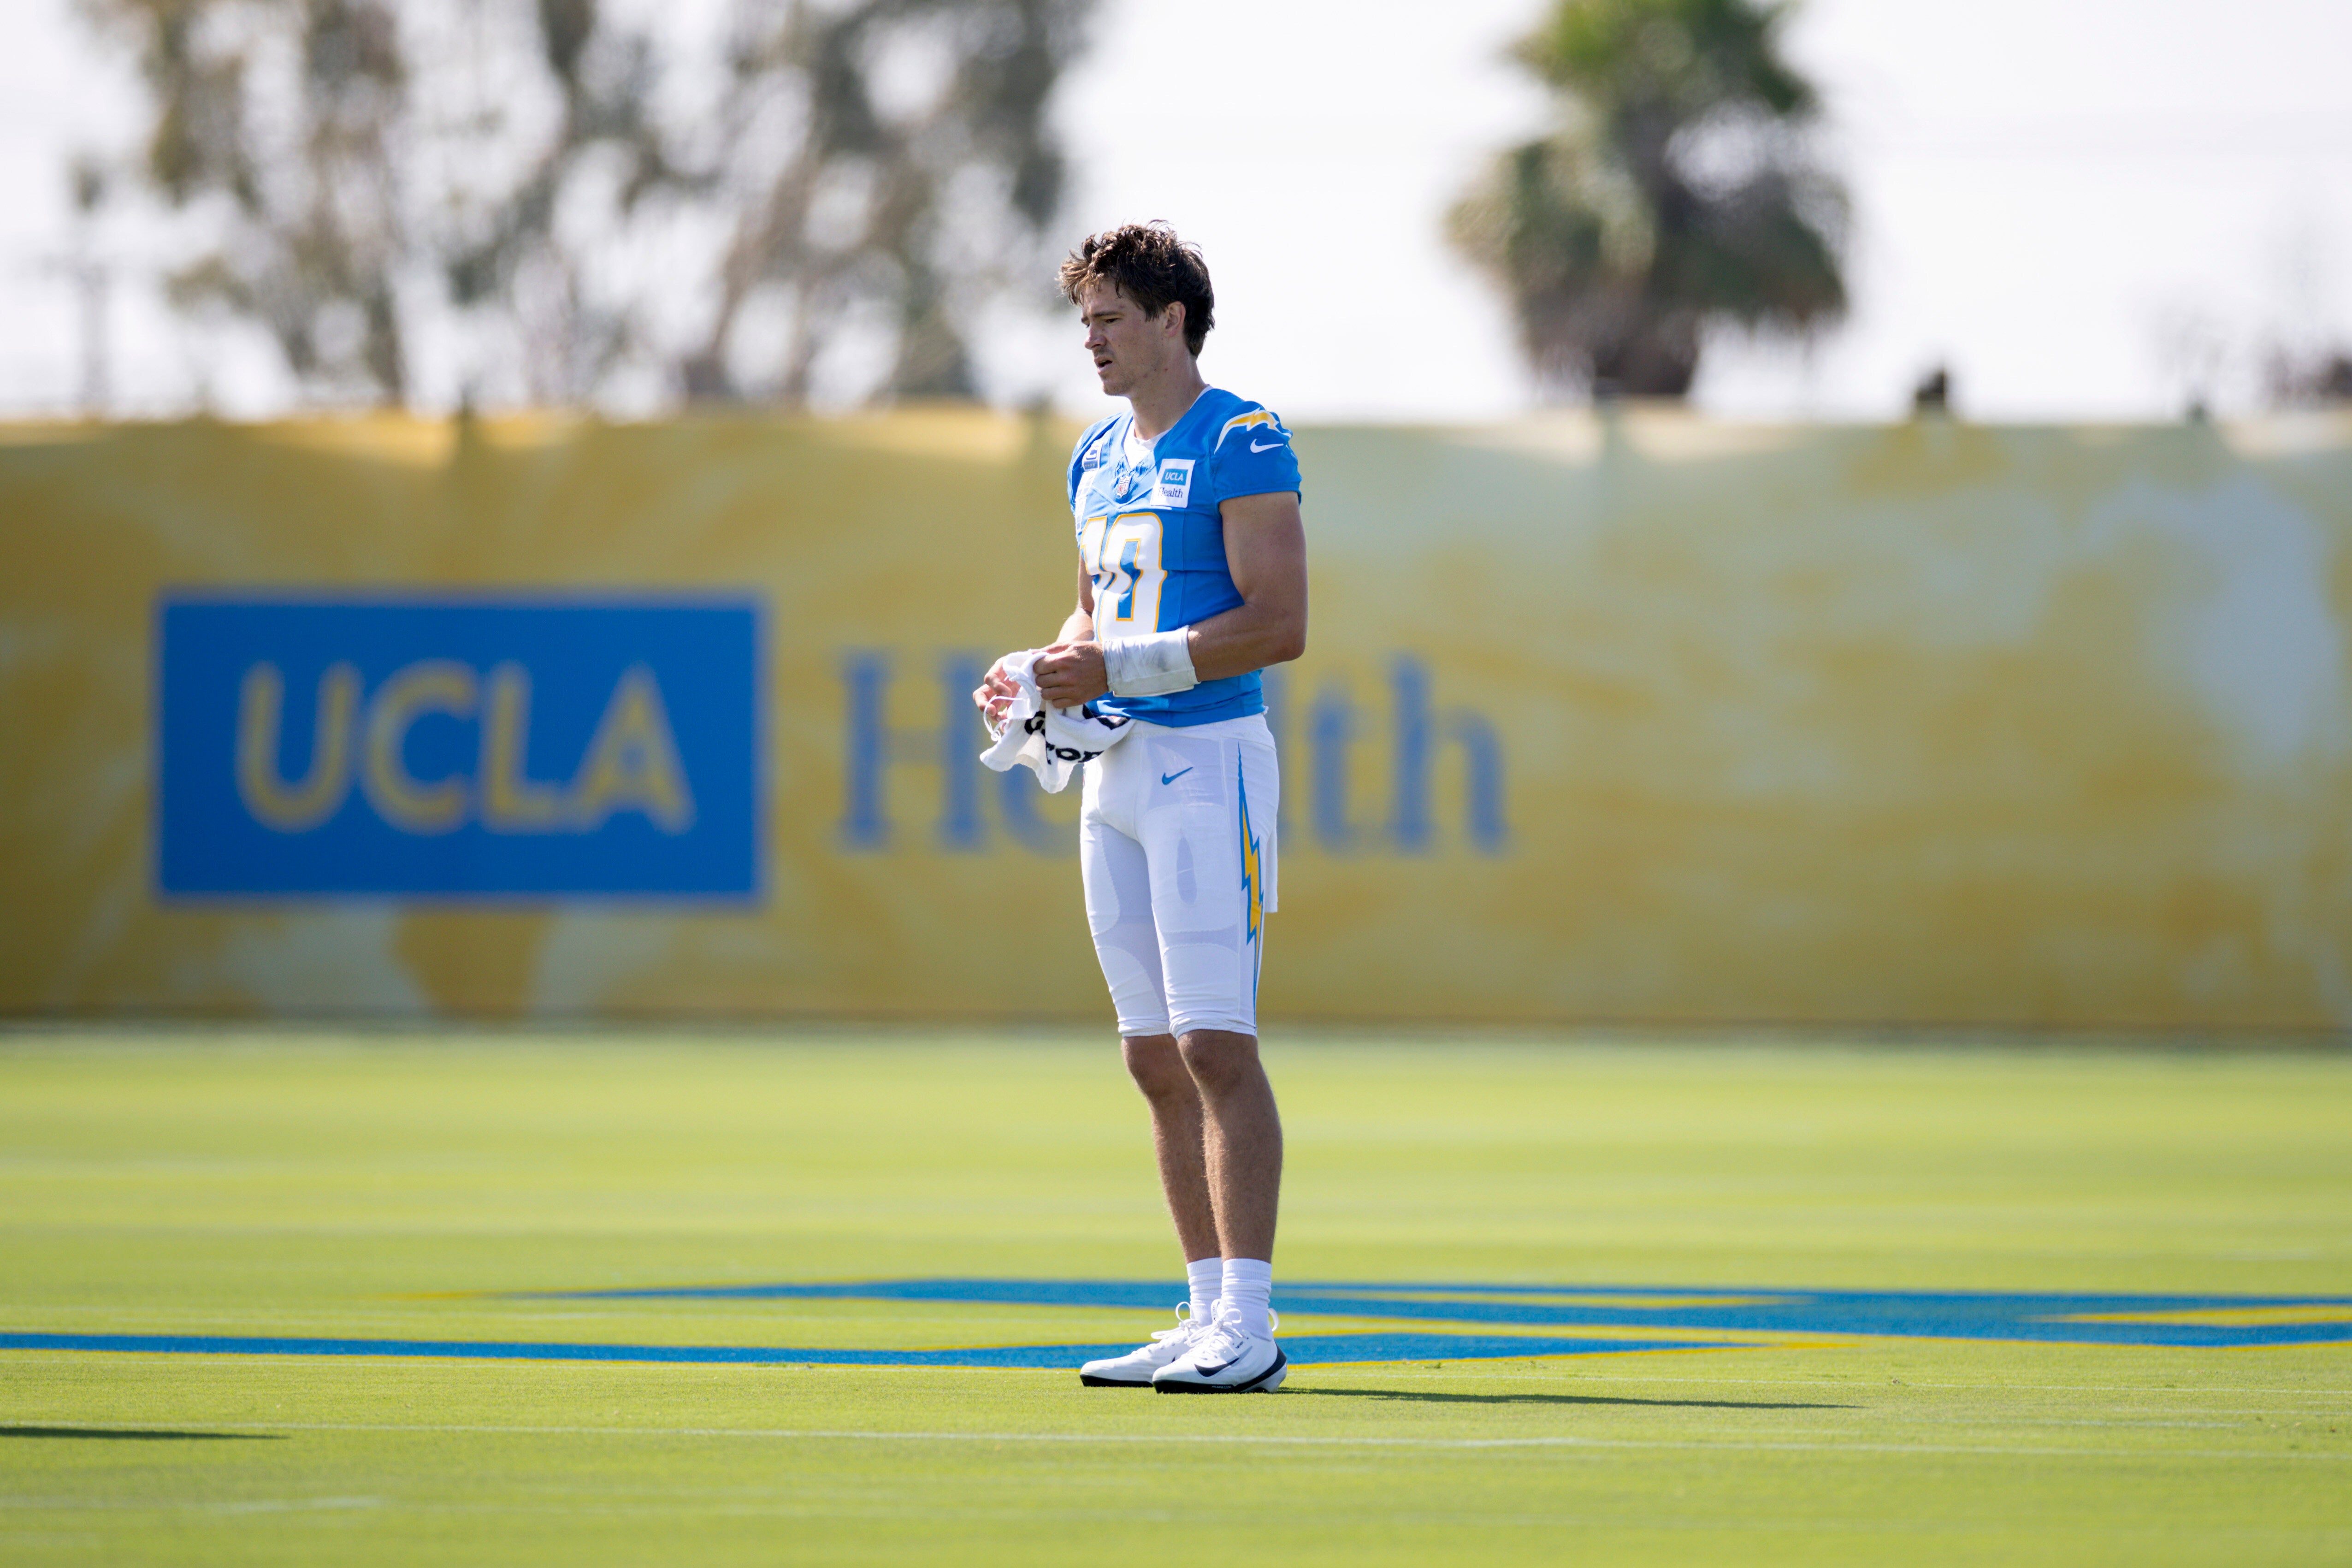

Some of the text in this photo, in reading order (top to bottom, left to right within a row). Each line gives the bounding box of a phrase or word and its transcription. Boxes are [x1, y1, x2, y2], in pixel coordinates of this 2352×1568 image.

[1158, 487, 1183, 498] Health
[1165, 472, 1183, 481] UCLA
[1080, 512, 1168, 642] 10
[238, 649, 1516, 858] UCLA Hth
